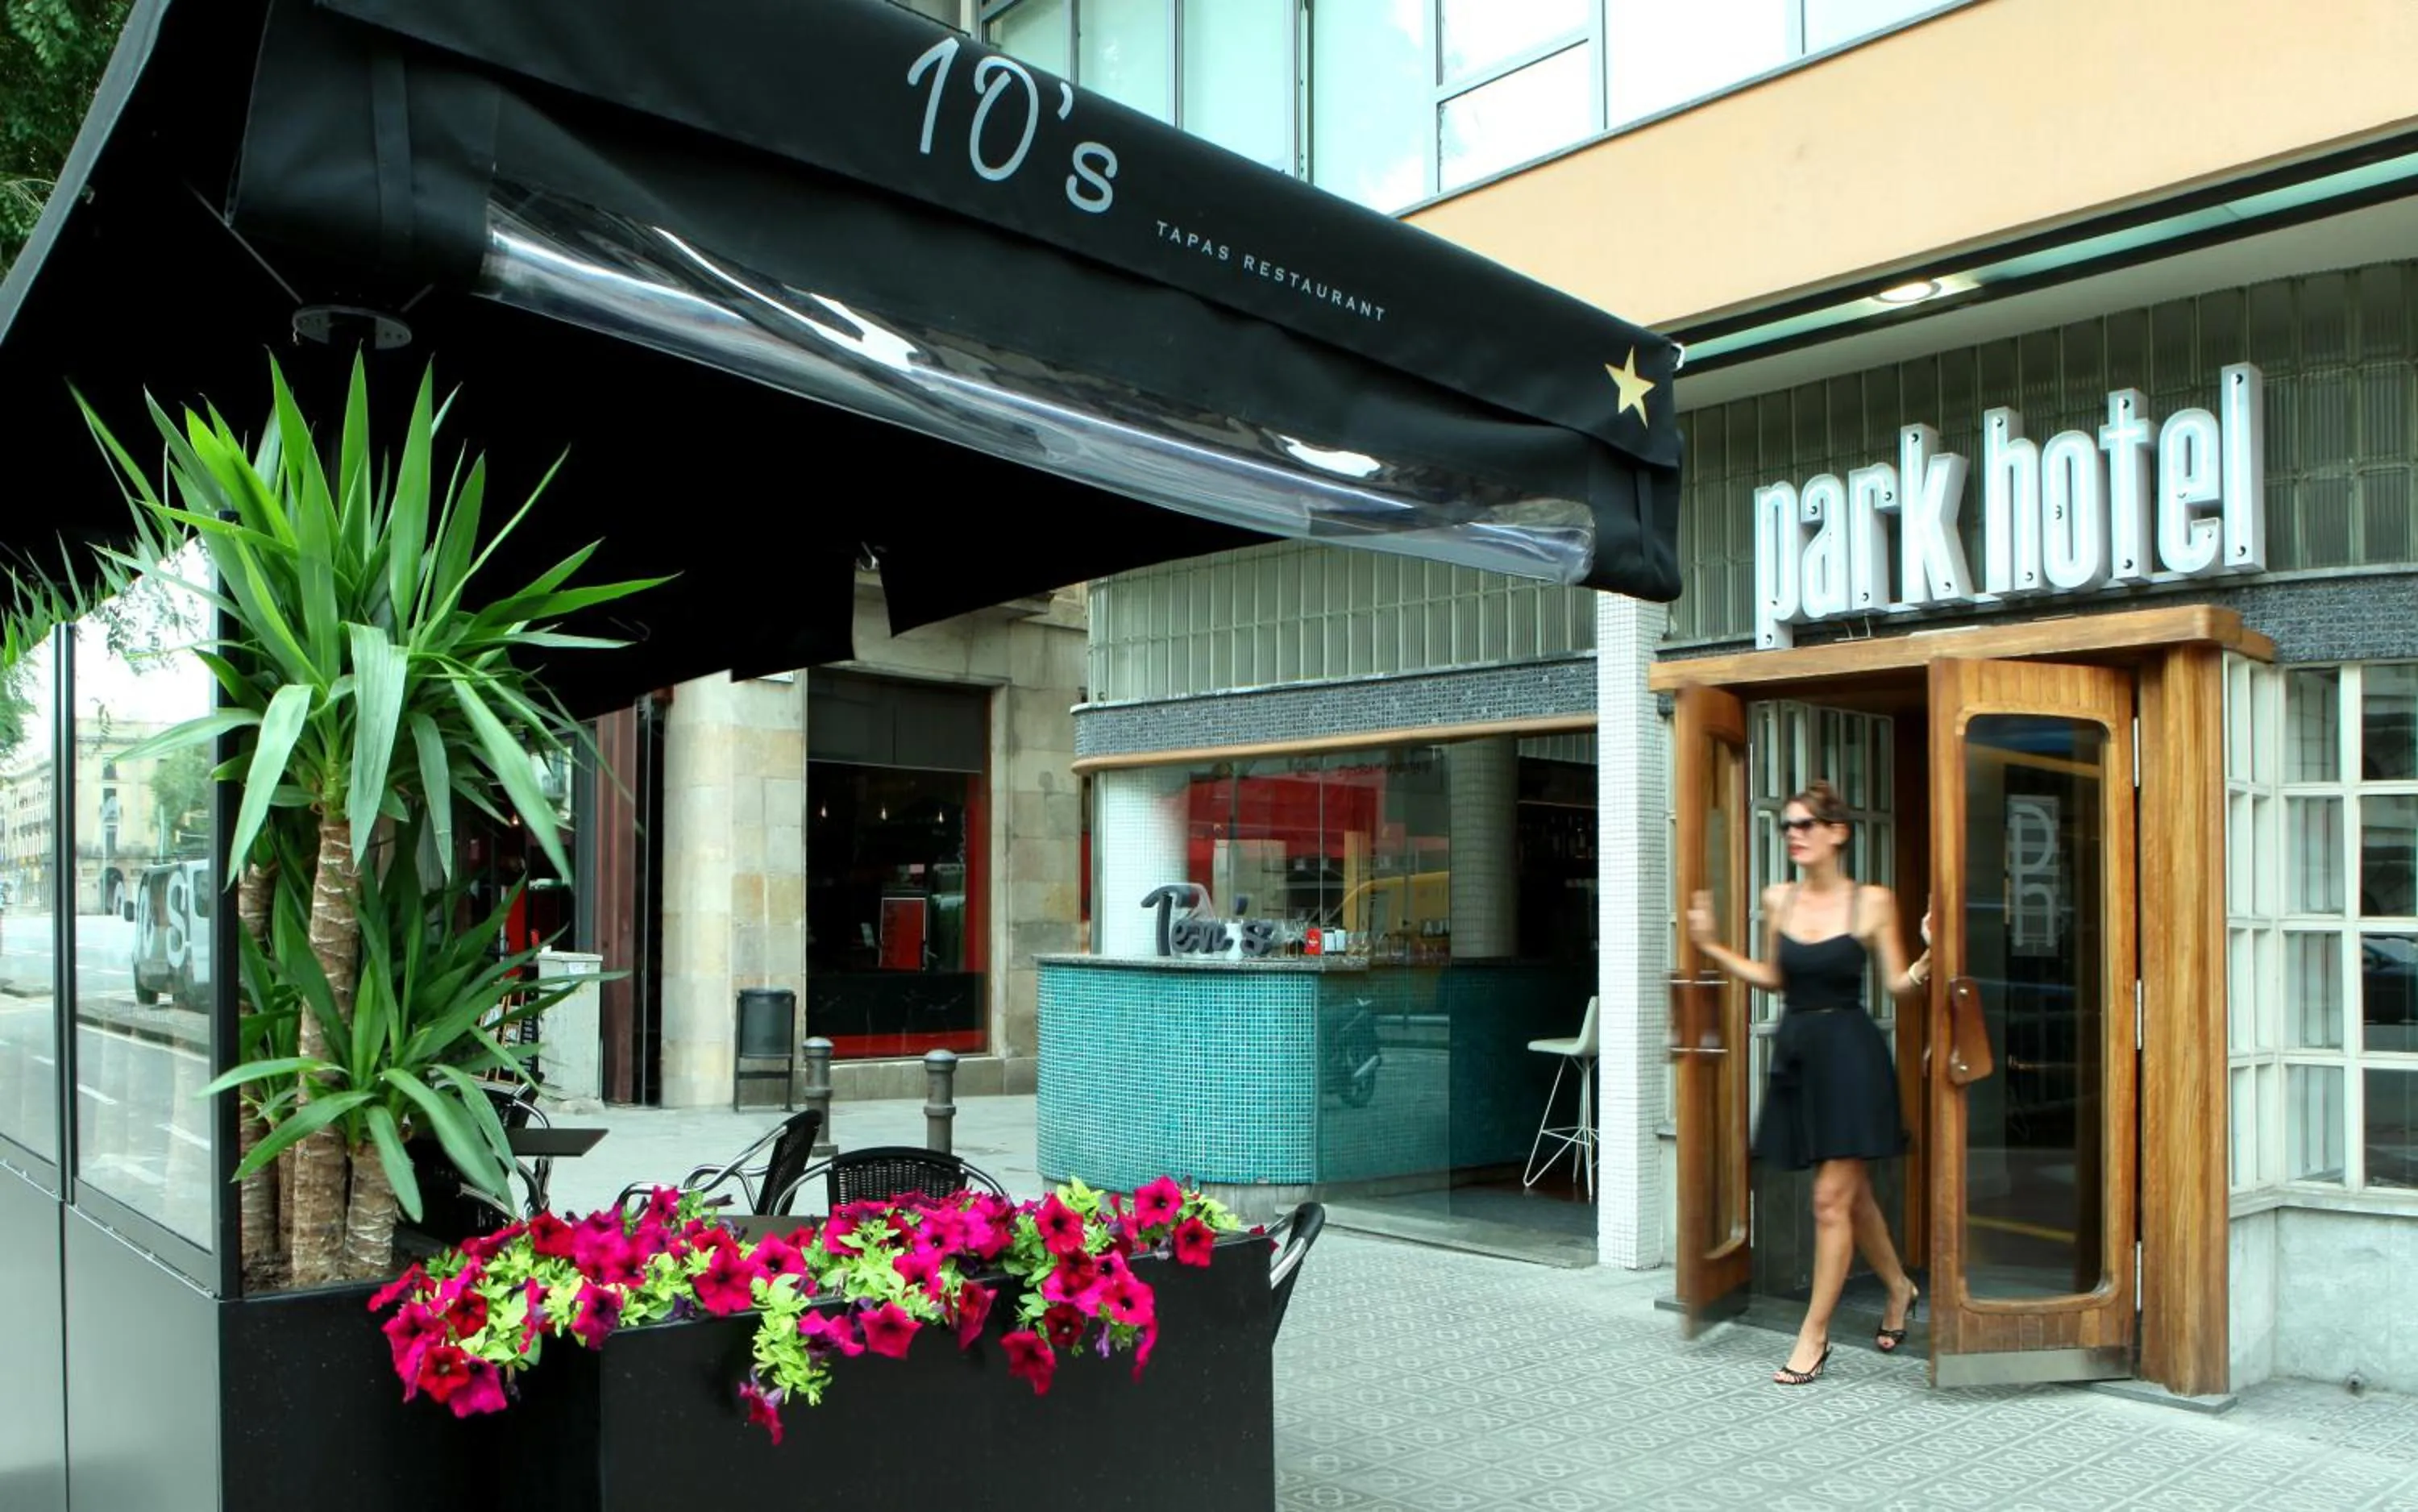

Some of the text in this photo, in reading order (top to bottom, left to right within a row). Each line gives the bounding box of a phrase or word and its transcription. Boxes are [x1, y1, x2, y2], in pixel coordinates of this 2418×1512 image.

[907, 36, 1119, 214] 10's
[1156, 219, 1386, 322] TAPAS RESTAURANT
[1754, 361, 2266, 650] park hotel
